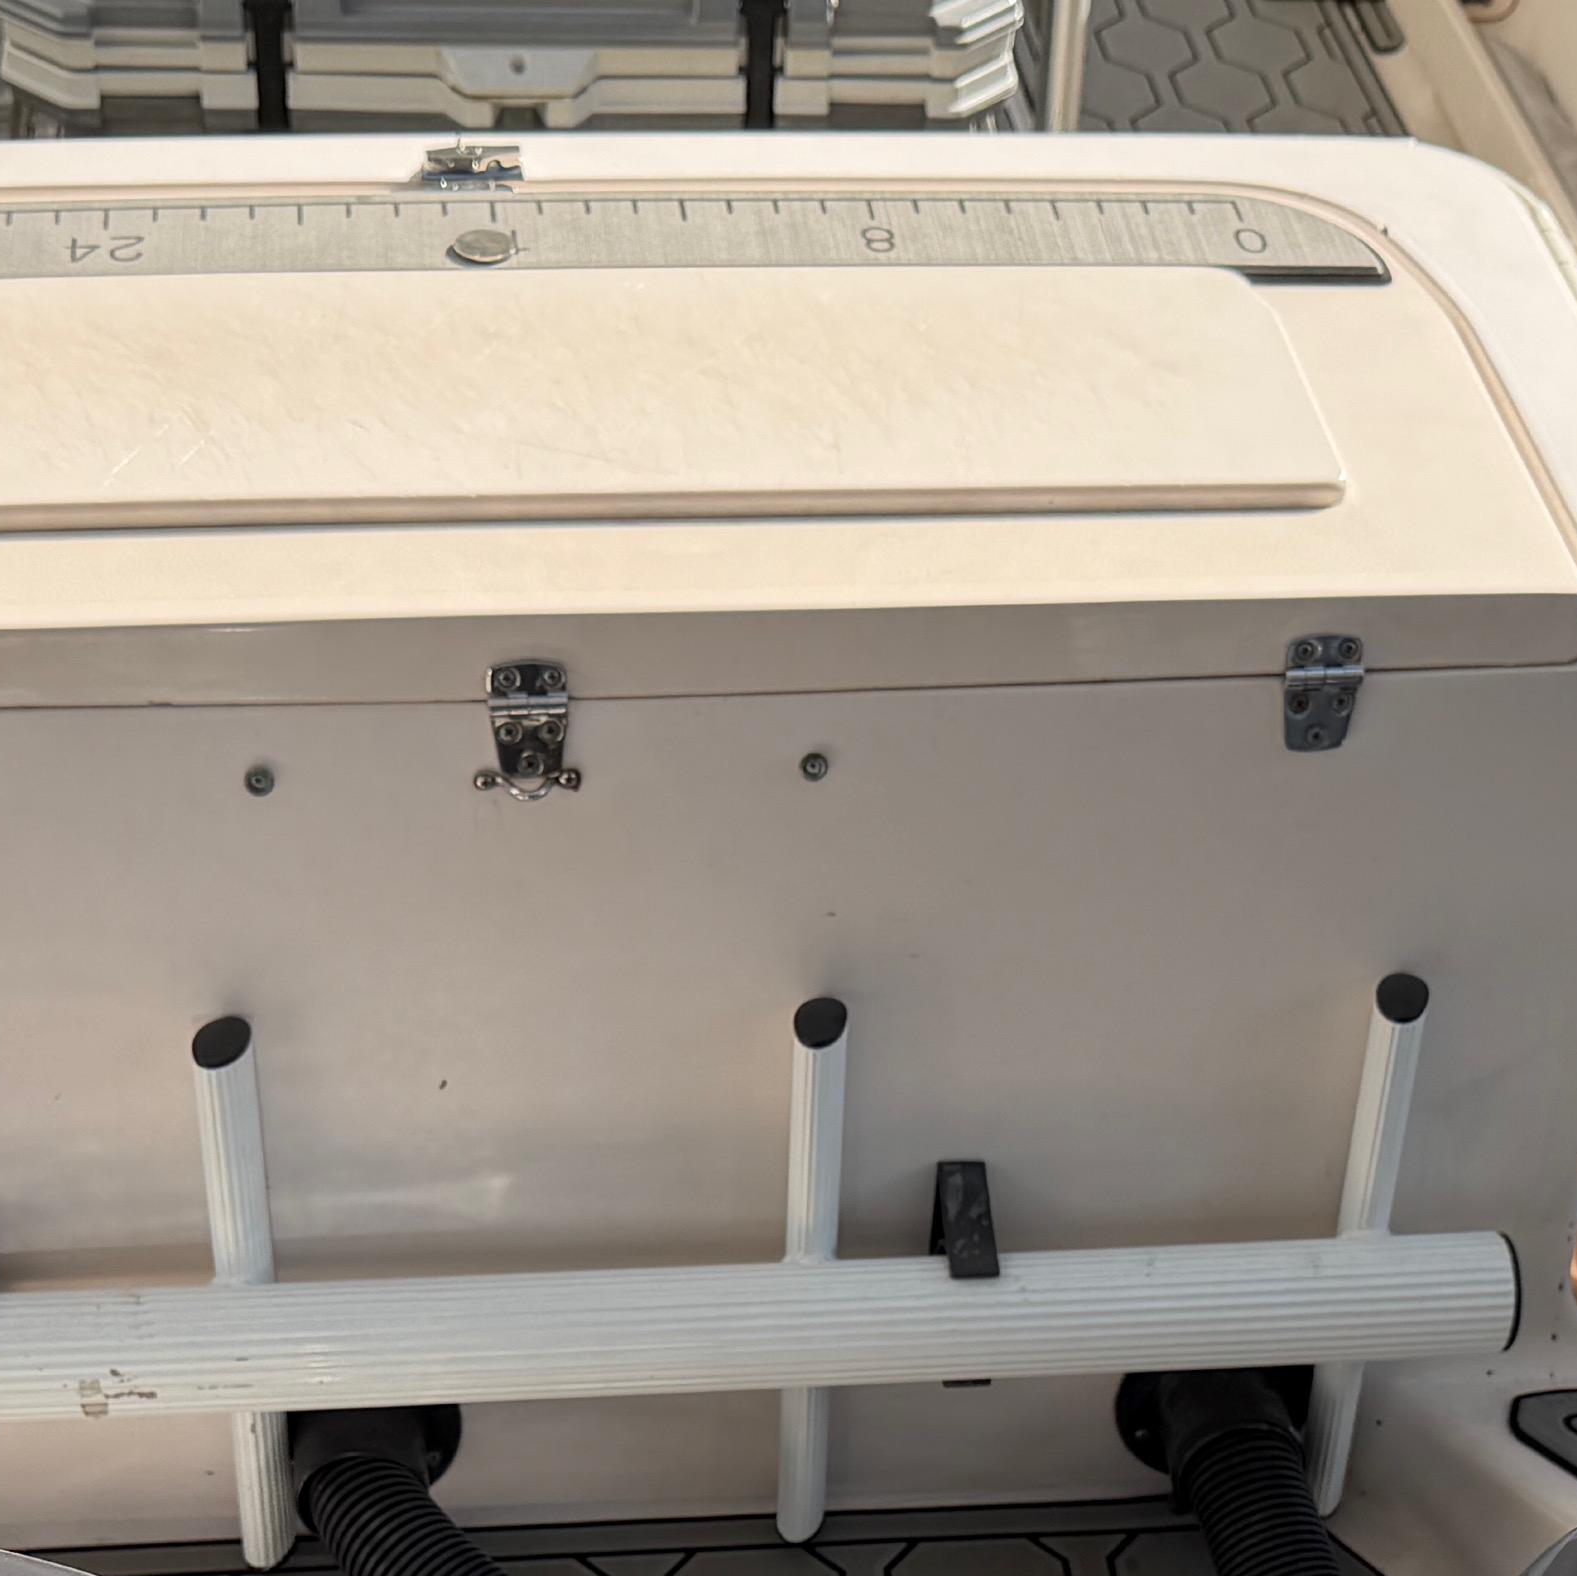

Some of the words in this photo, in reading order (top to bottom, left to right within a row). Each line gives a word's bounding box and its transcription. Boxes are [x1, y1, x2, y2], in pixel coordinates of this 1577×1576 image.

[63, 235, 145, 264] 24
[860, 226, 896, 253] 8
[1233, 228, 1268, 254] 0
